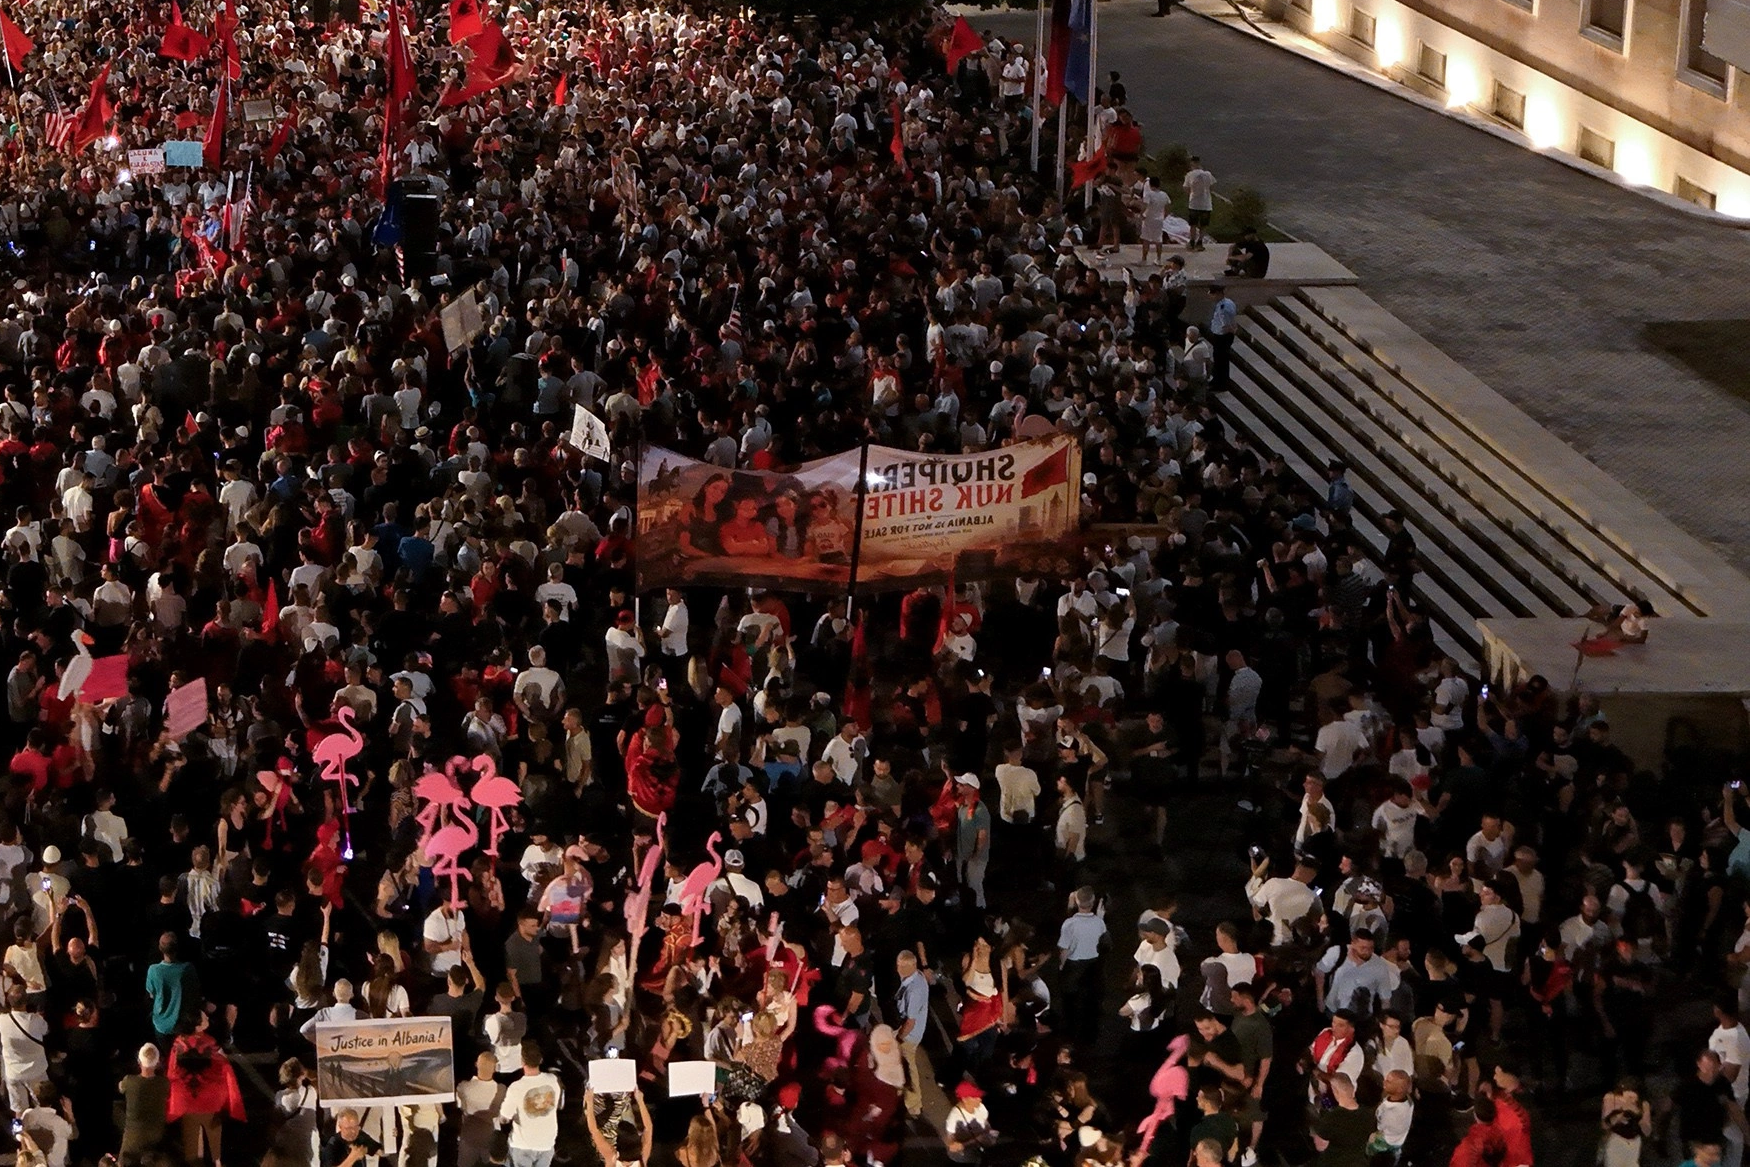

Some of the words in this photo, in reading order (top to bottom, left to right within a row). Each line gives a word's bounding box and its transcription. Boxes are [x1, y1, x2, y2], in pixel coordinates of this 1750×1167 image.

[330, 1034, 374, 1053] Justice
[377, 1035, 388, 1047] in
[392, 1027, 442, 1047] Albania!
